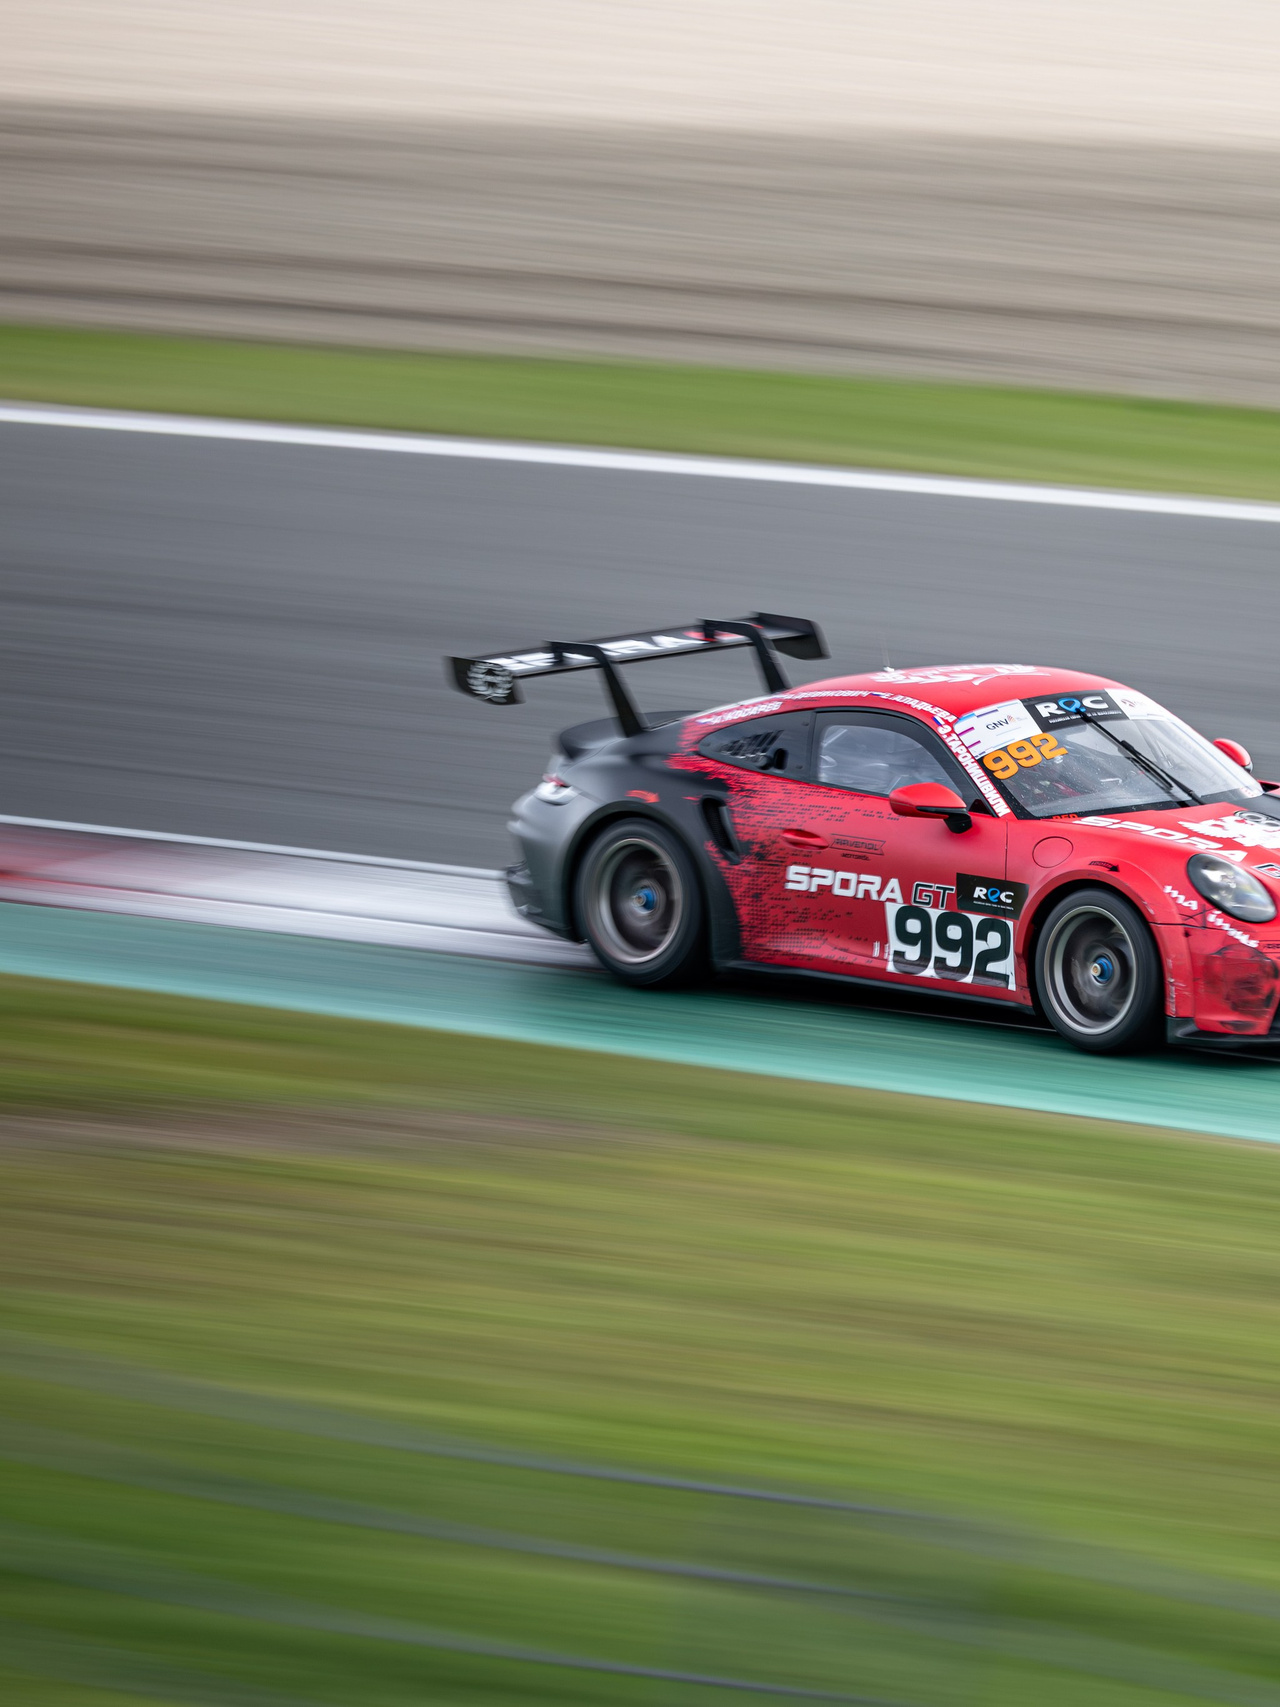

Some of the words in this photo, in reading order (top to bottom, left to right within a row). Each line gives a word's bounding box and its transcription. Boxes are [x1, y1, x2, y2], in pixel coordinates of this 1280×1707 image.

[985, 717, 1010, 731] GNV
[982, 732, 1069, 780] 992
[1072, 816, 1249, 863] SPORA
[784, 864, 904, 904] SPORA
[911, 880, 956, 911] GT
[892, 904, 1012, 989] 992
